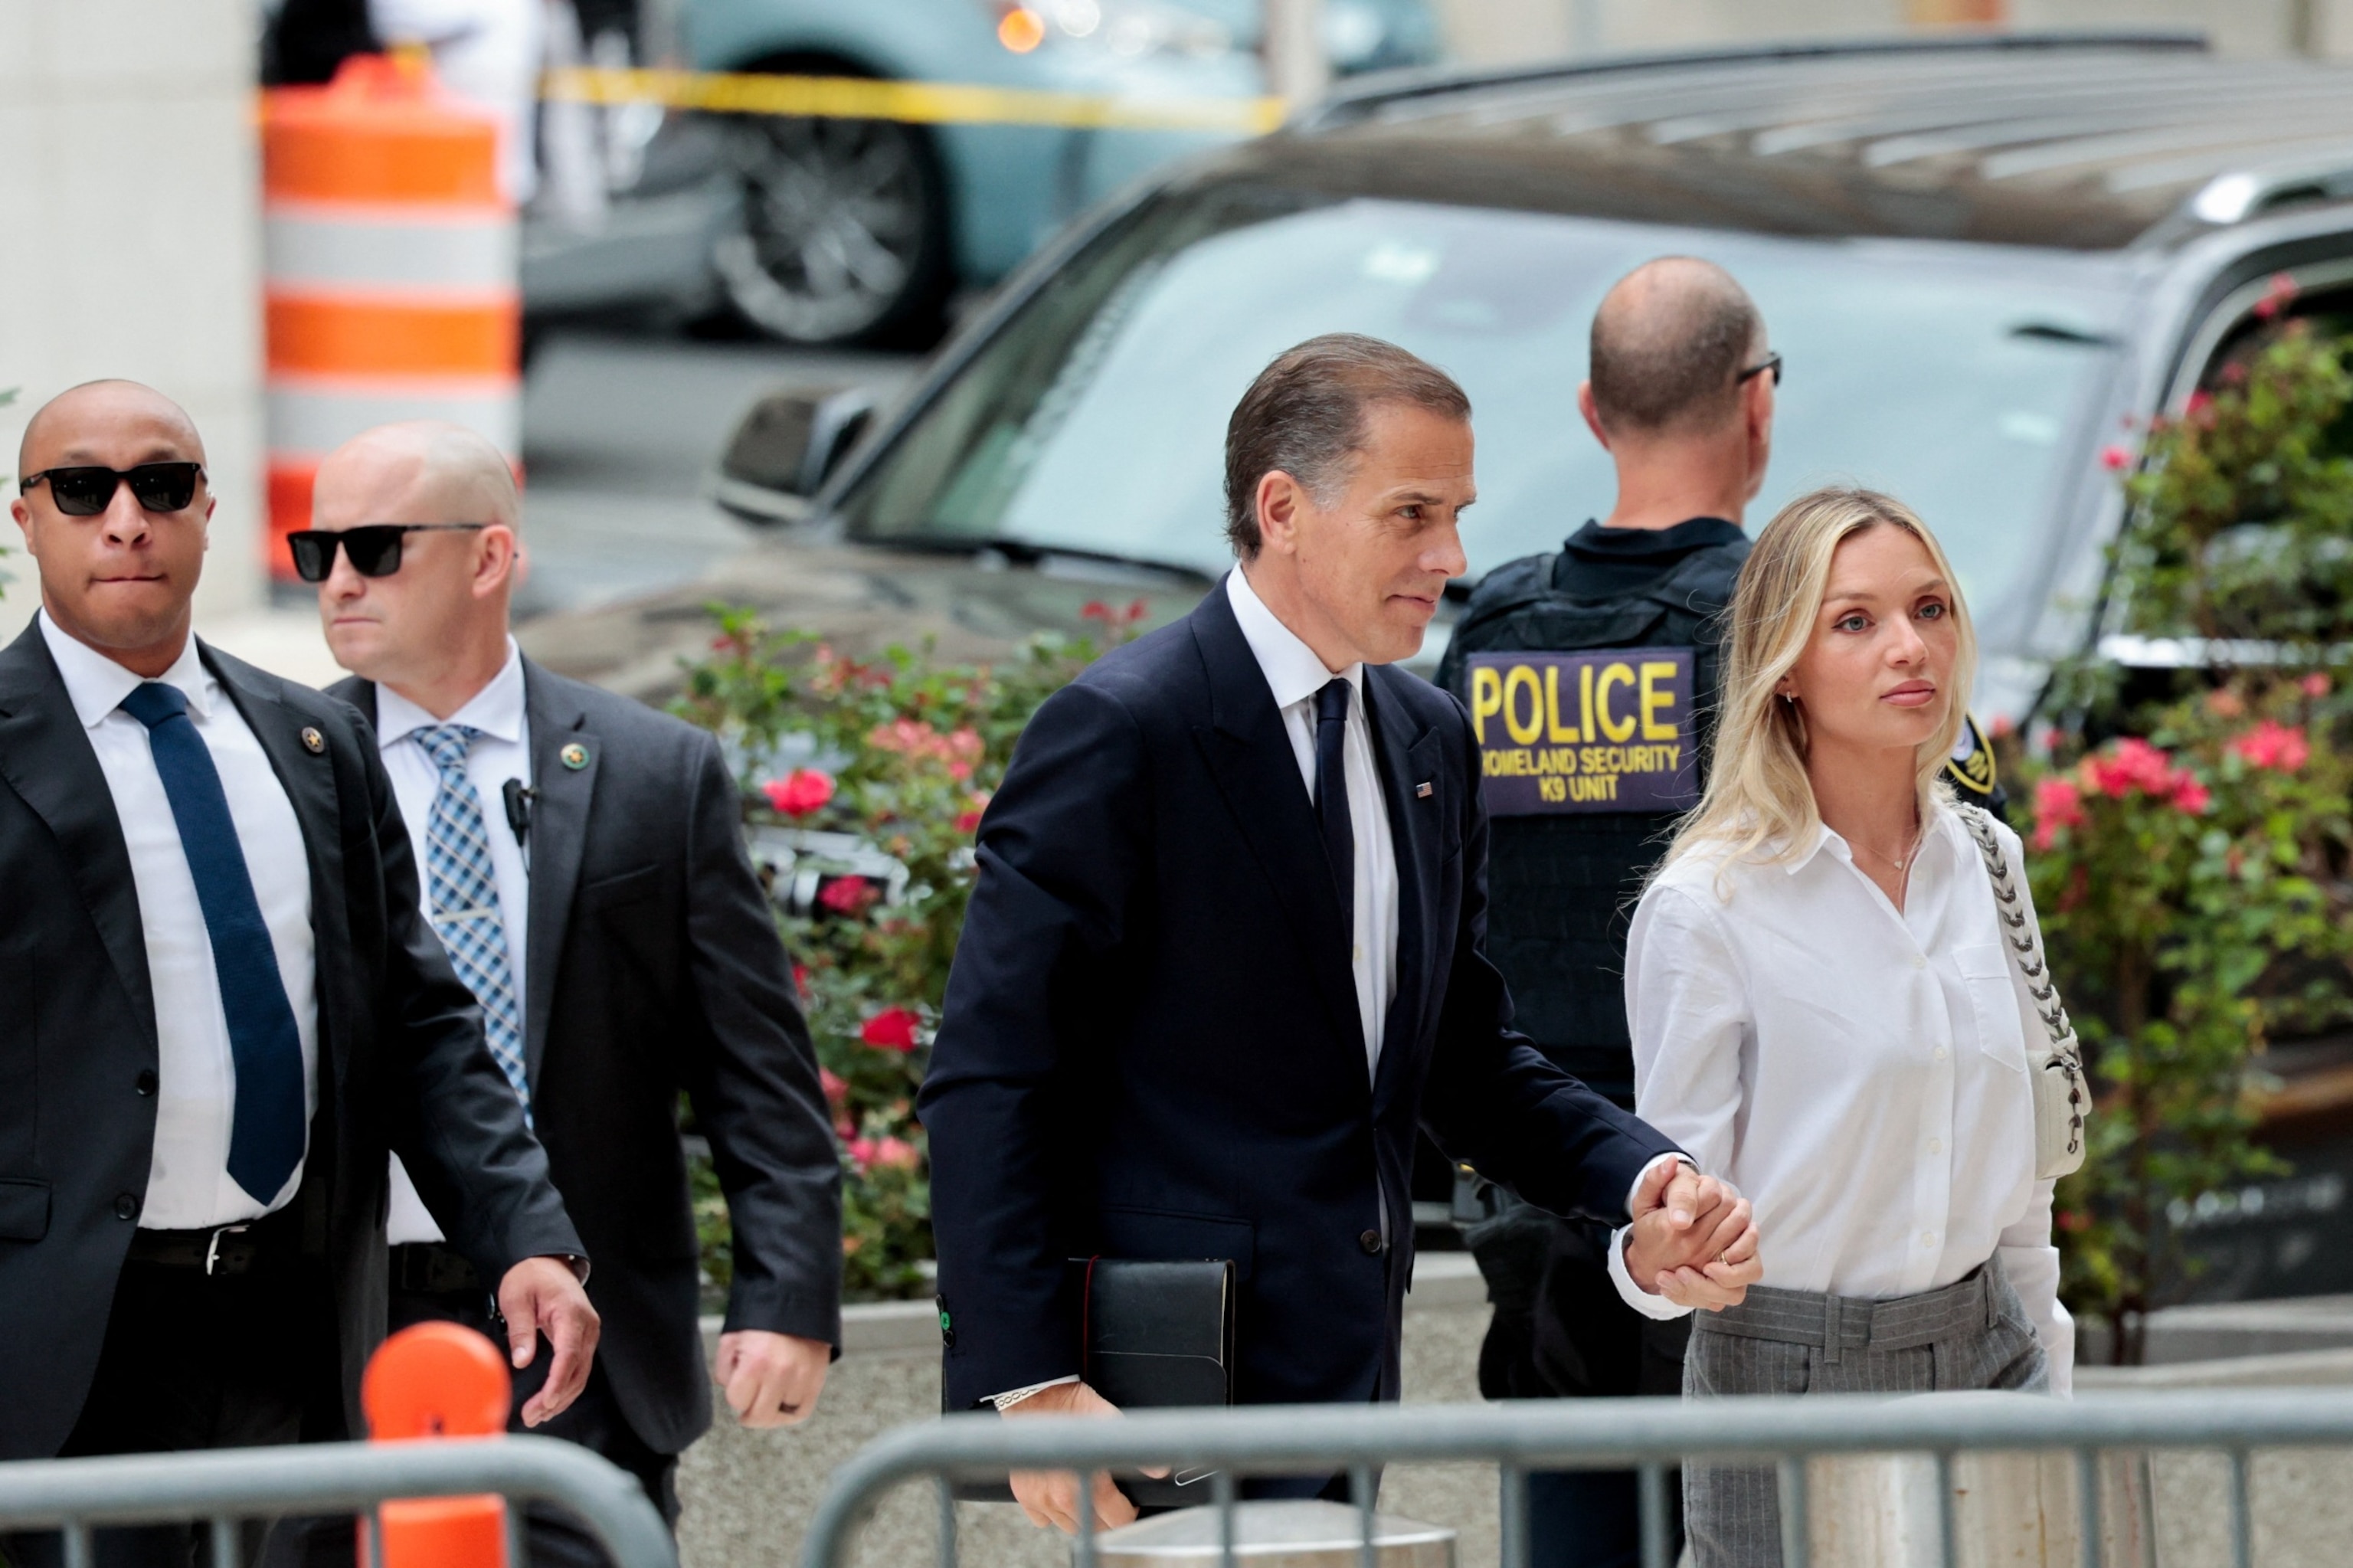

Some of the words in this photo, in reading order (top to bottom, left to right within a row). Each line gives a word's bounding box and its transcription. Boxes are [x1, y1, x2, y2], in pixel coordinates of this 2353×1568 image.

[1472, 662, 1678, 745] POLICE
[1580, 745, 1680, 774] SECURITY
[1539, 775, 1565, 803] K9
[1569, 774, 1618, 802] UNIT
